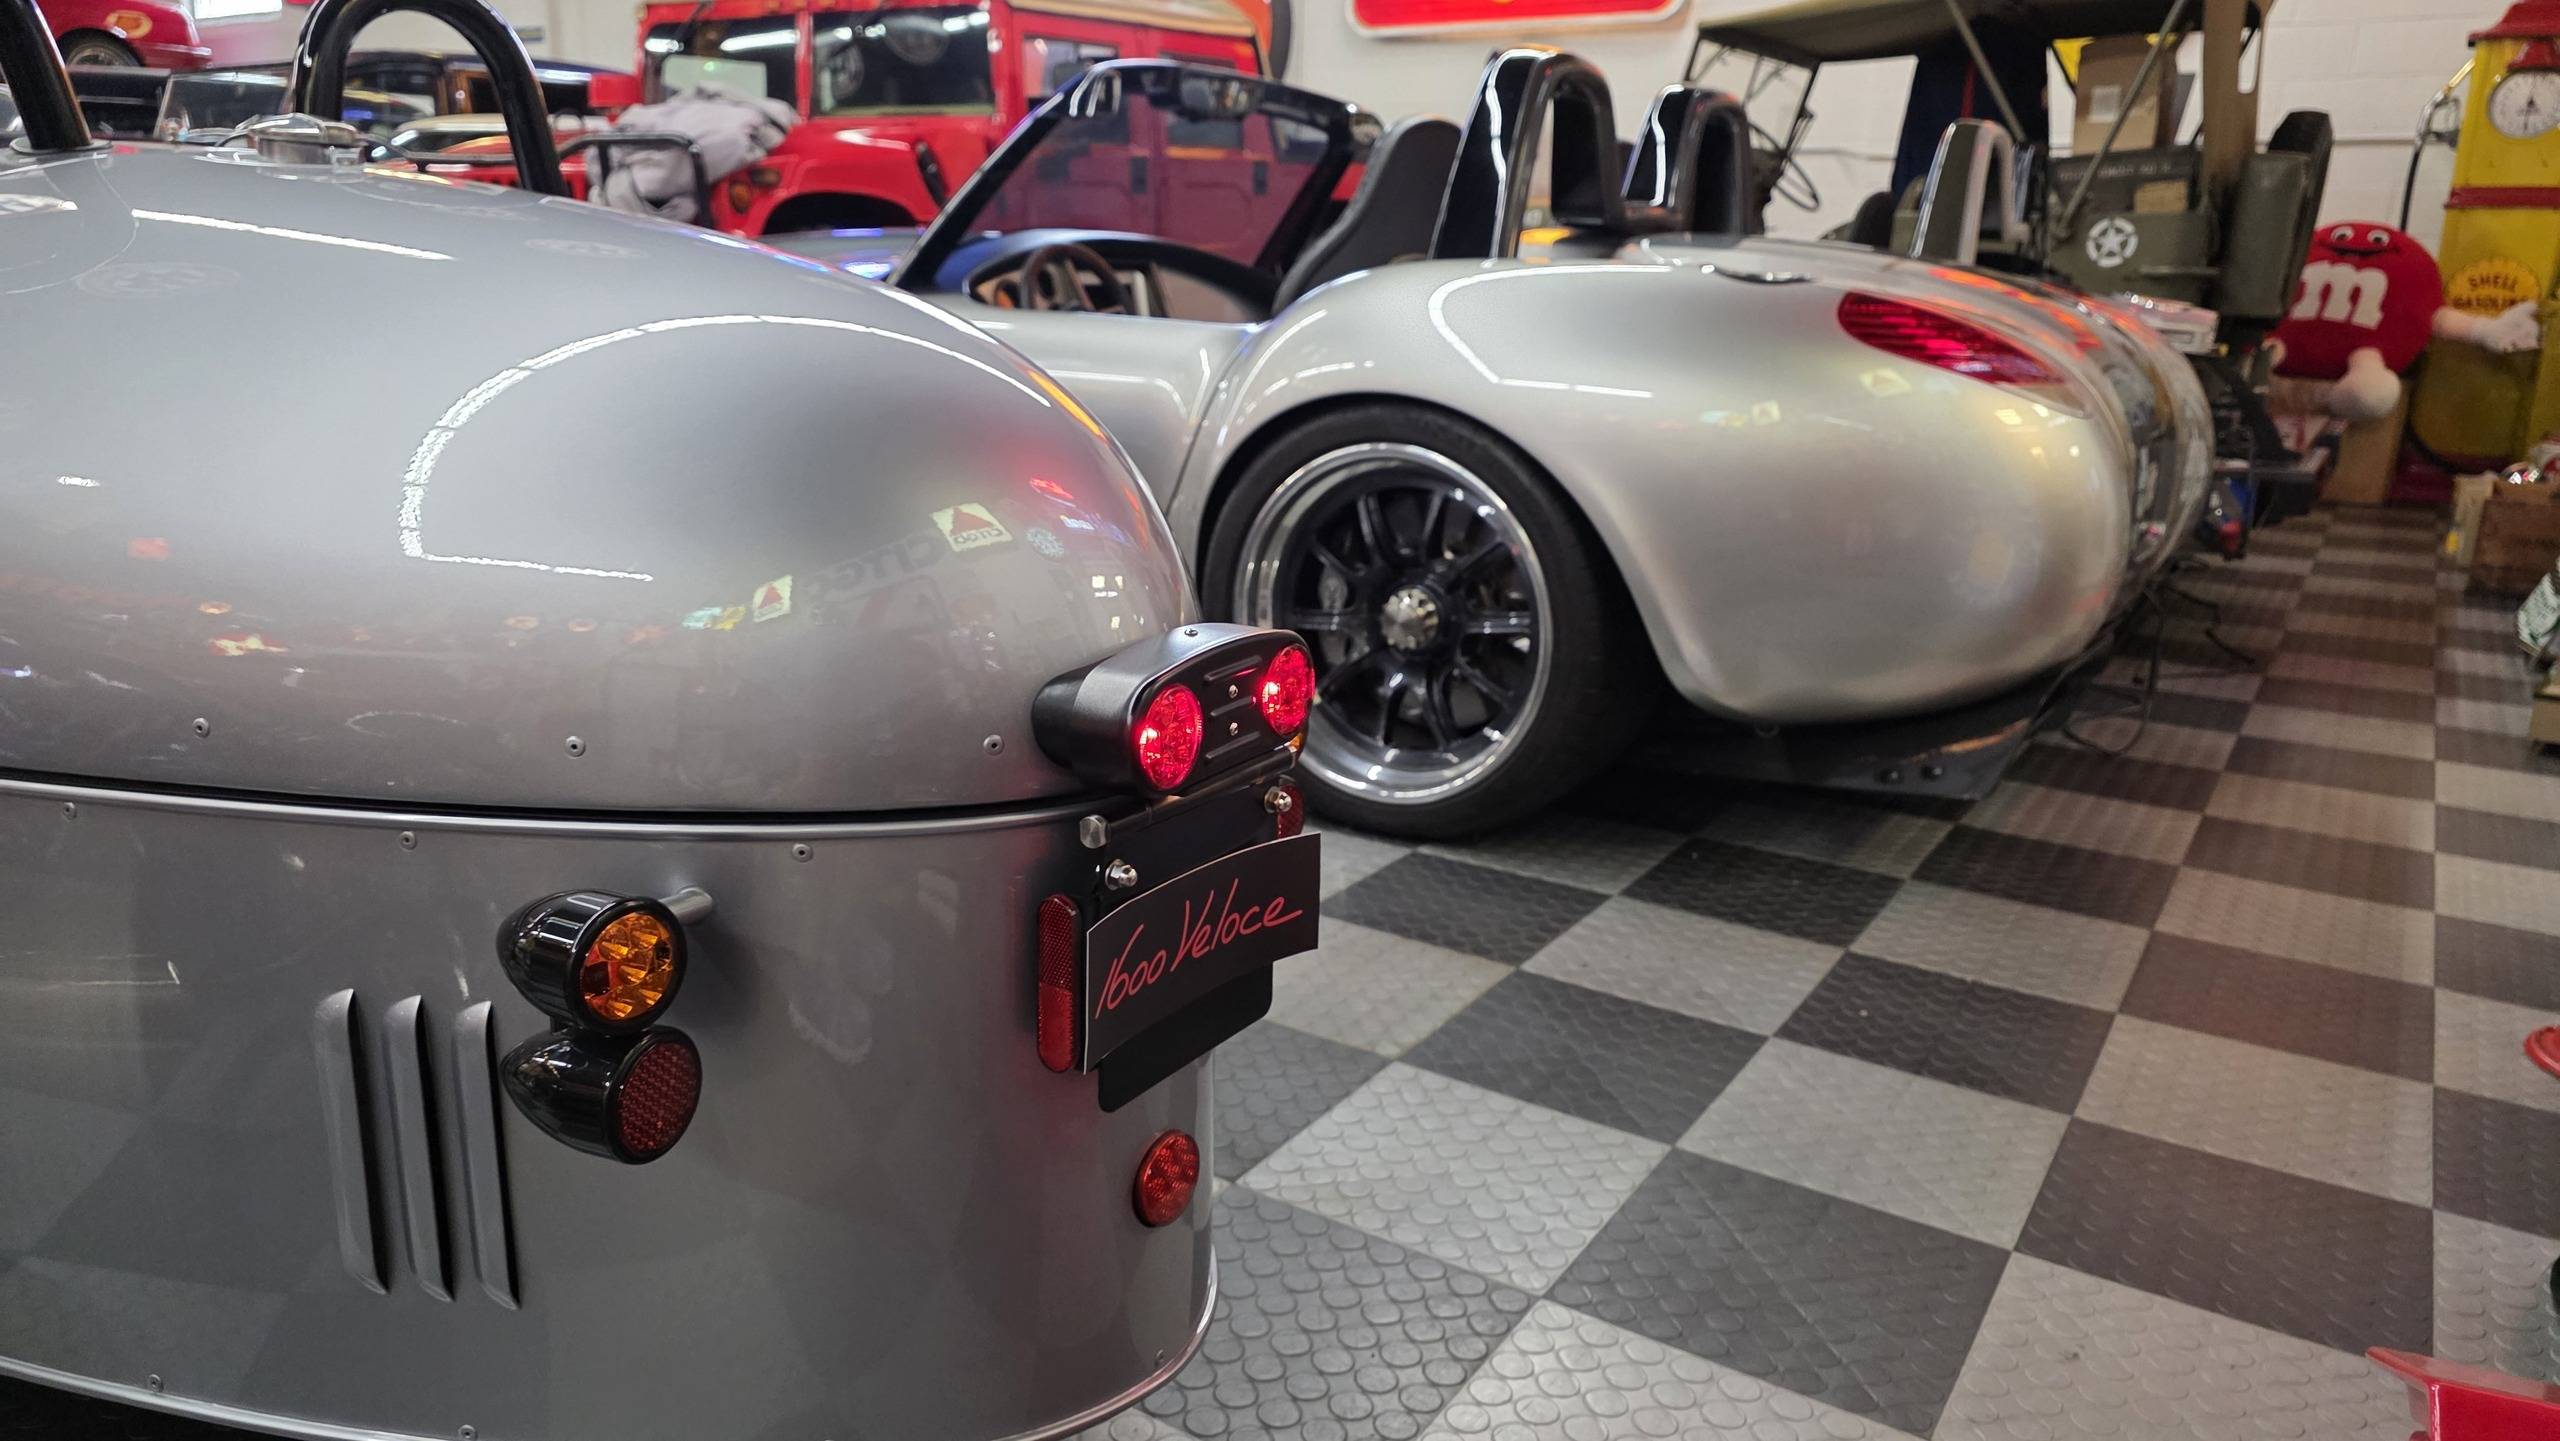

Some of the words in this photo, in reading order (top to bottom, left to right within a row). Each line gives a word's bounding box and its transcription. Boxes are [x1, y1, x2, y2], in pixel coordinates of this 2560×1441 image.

[2468, 273, 2518, 291] SHELL
[1095, 923, 1167, 1019] 1600
[1170, 878, 1303, 972] Veloce
